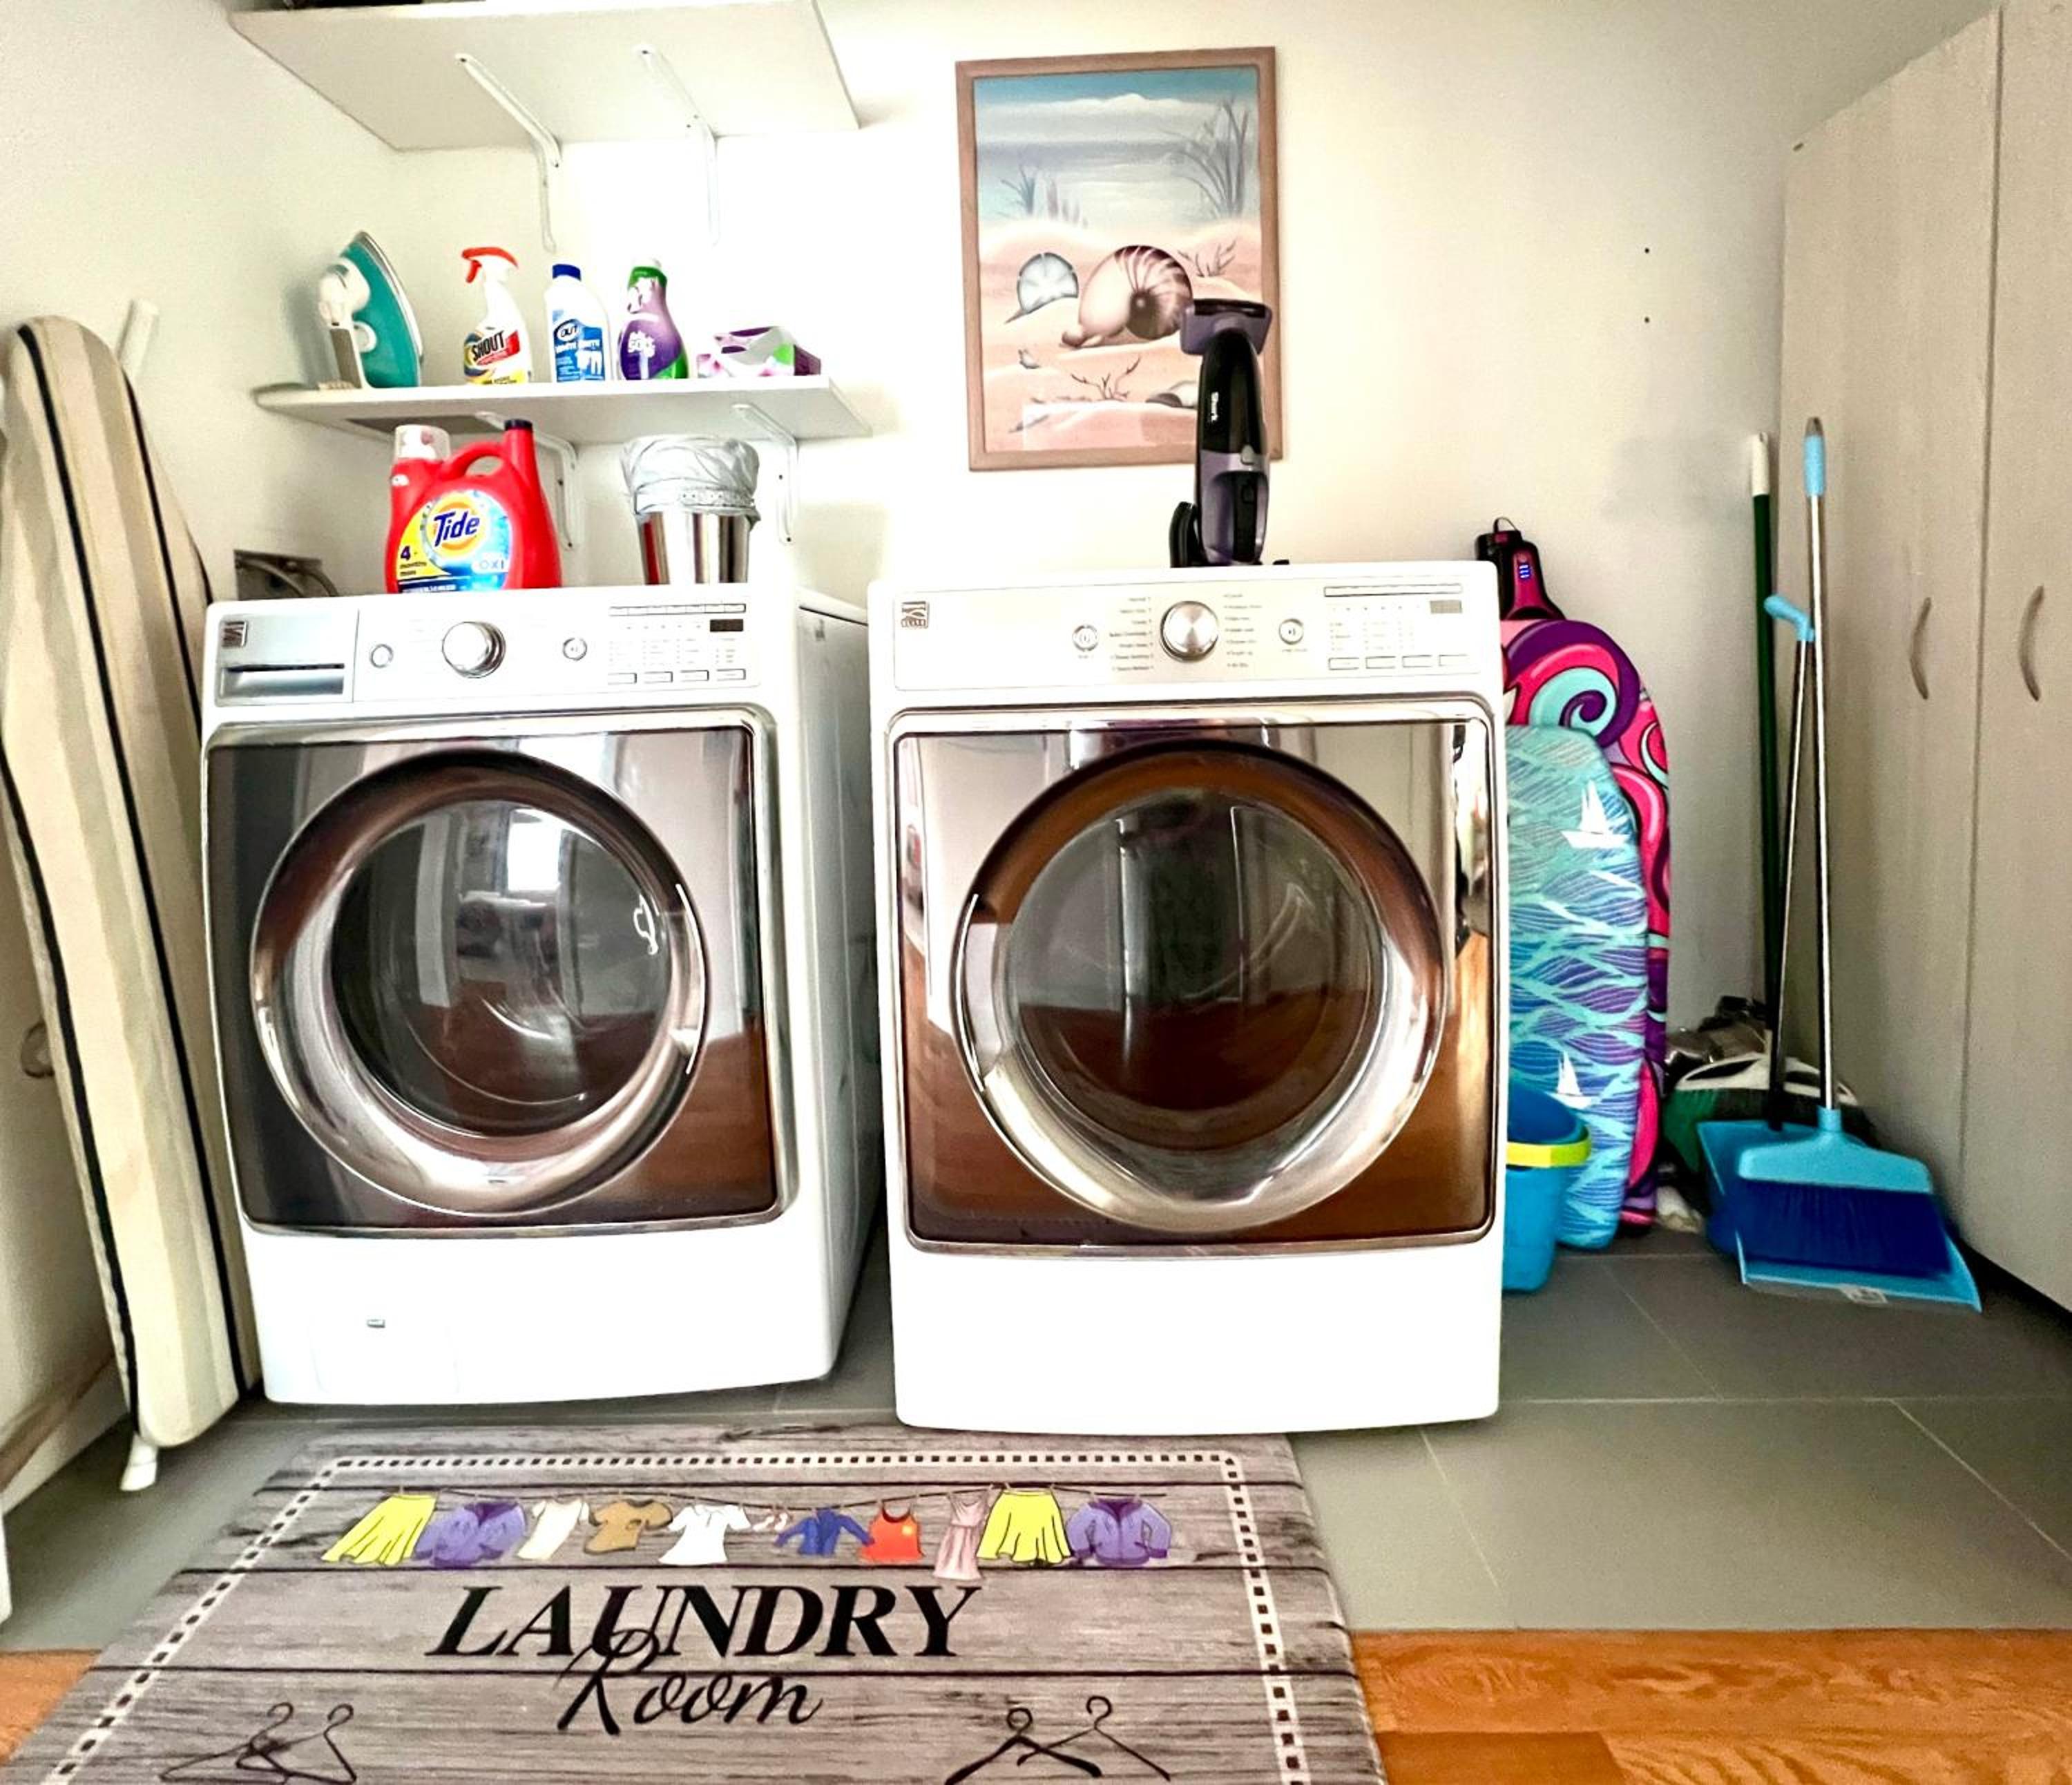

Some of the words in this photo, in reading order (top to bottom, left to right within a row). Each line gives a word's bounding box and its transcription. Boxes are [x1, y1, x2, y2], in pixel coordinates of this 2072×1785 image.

[471, 330, 505, 361] SHOUT
[560, 323, 578, 338] OUT
[433, 510, 480, 547] Tide
[400, 545, 411, 561] 4
[479, 560, 505, 570] OXI
[425, 1584, 983, 1659] LAUNDRY
[557, 1626, 825, 1736] Room
